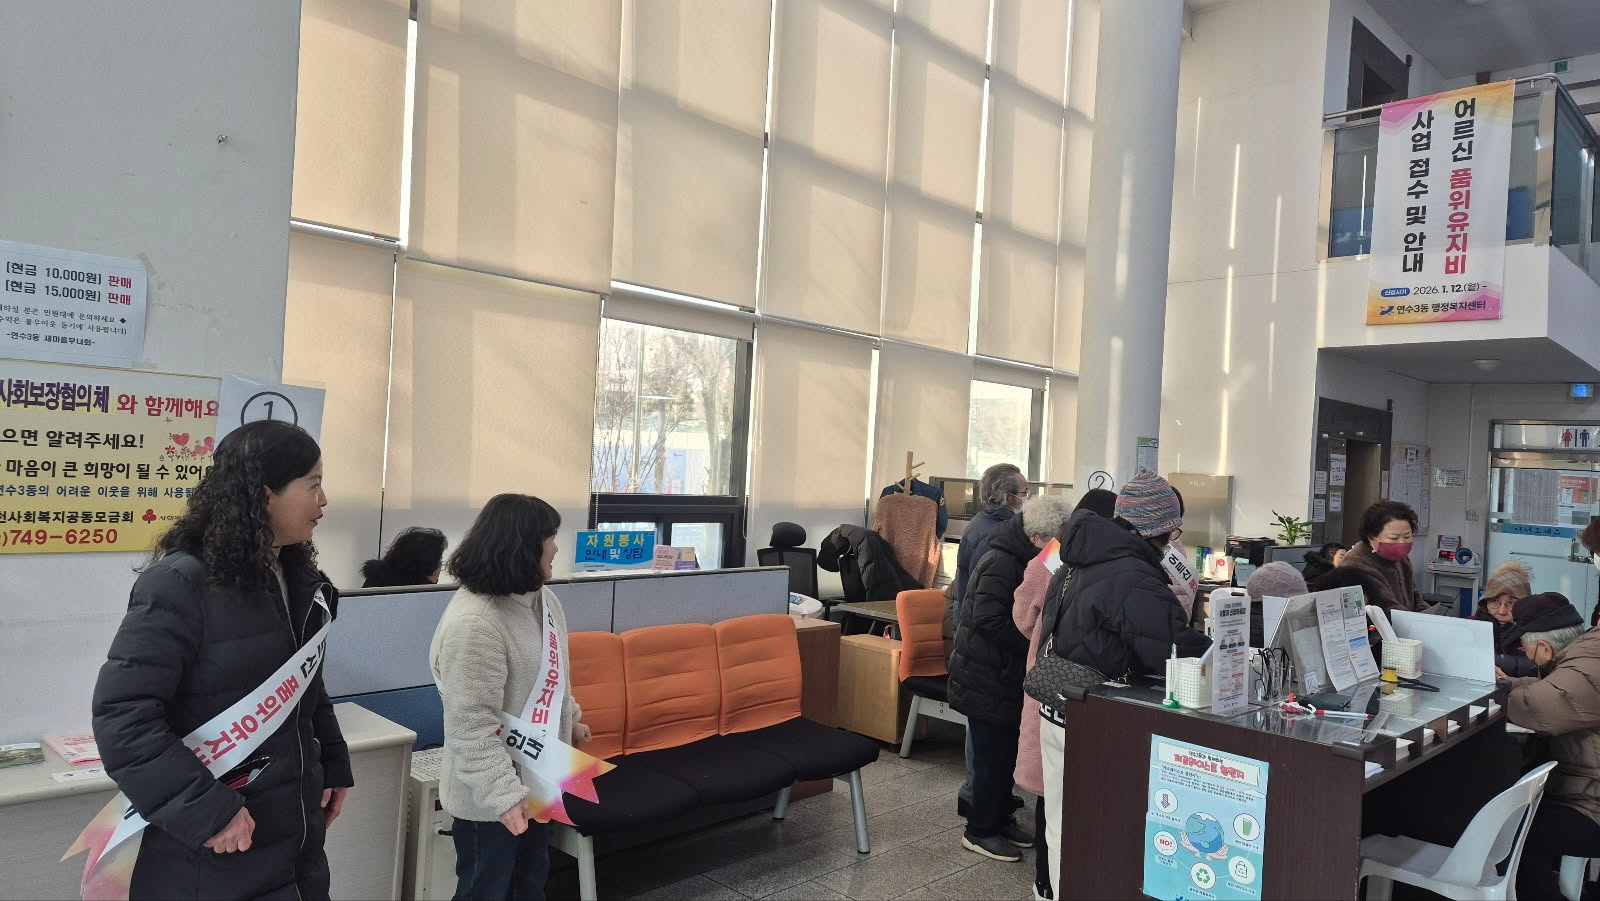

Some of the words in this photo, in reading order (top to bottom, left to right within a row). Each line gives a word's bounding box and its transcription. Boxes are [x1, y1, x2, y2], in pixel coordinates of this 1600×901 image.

[1411, 110, 1434, 152] 사업
[1452, 97, 1477, 162] 어르신
[1406, 157, 1430, 199] 접수
[1406, 205, 1427, 226] 및
[1444, 167, 1473, 275] 품위유지비
[1402, 231, 1427, 273] 안내
[6, 261, 38, 277] [현금
[107, 275, 132, 289] 판매
[5, 279, 36, 294] [현금
[107, 292, 131, 305] 판매
[1413, 286, 1440, 296] 2026.
[1396, 304, 1430, 315] 연수3동
[1431, 300, 1486, 313] 행정복지센터
[0, 378, 110, 413] 사회보장협의체
[117, 393, 139, 415] 와
[145, 395, 220, 418] 함께해요
[0, 428, 39, 447] 으면
[46, 431, 144, 450] 알려주세요!
[6, 459, 57, 478] 마음이
[62, 461, 79, 478] 큰
[84, 462, 131, 480] 희망이
[136, 463, 150, 480] 될
[155, 464, 170, 480] 수
[56, 485, 91, 498] 어려운
[98, 485, 131, 498] 이웃을
[137, 486, 158, 498] 위해
[585, 549, 607, 561] 안내
[609, 548, 621, 560] 및
[622, 547, 644, 560] 상담
[531, 631, 560, 725] 품위유지비
[505, 728, 545, 761] 안내
[1159, 838, 1173, 848] NO!
